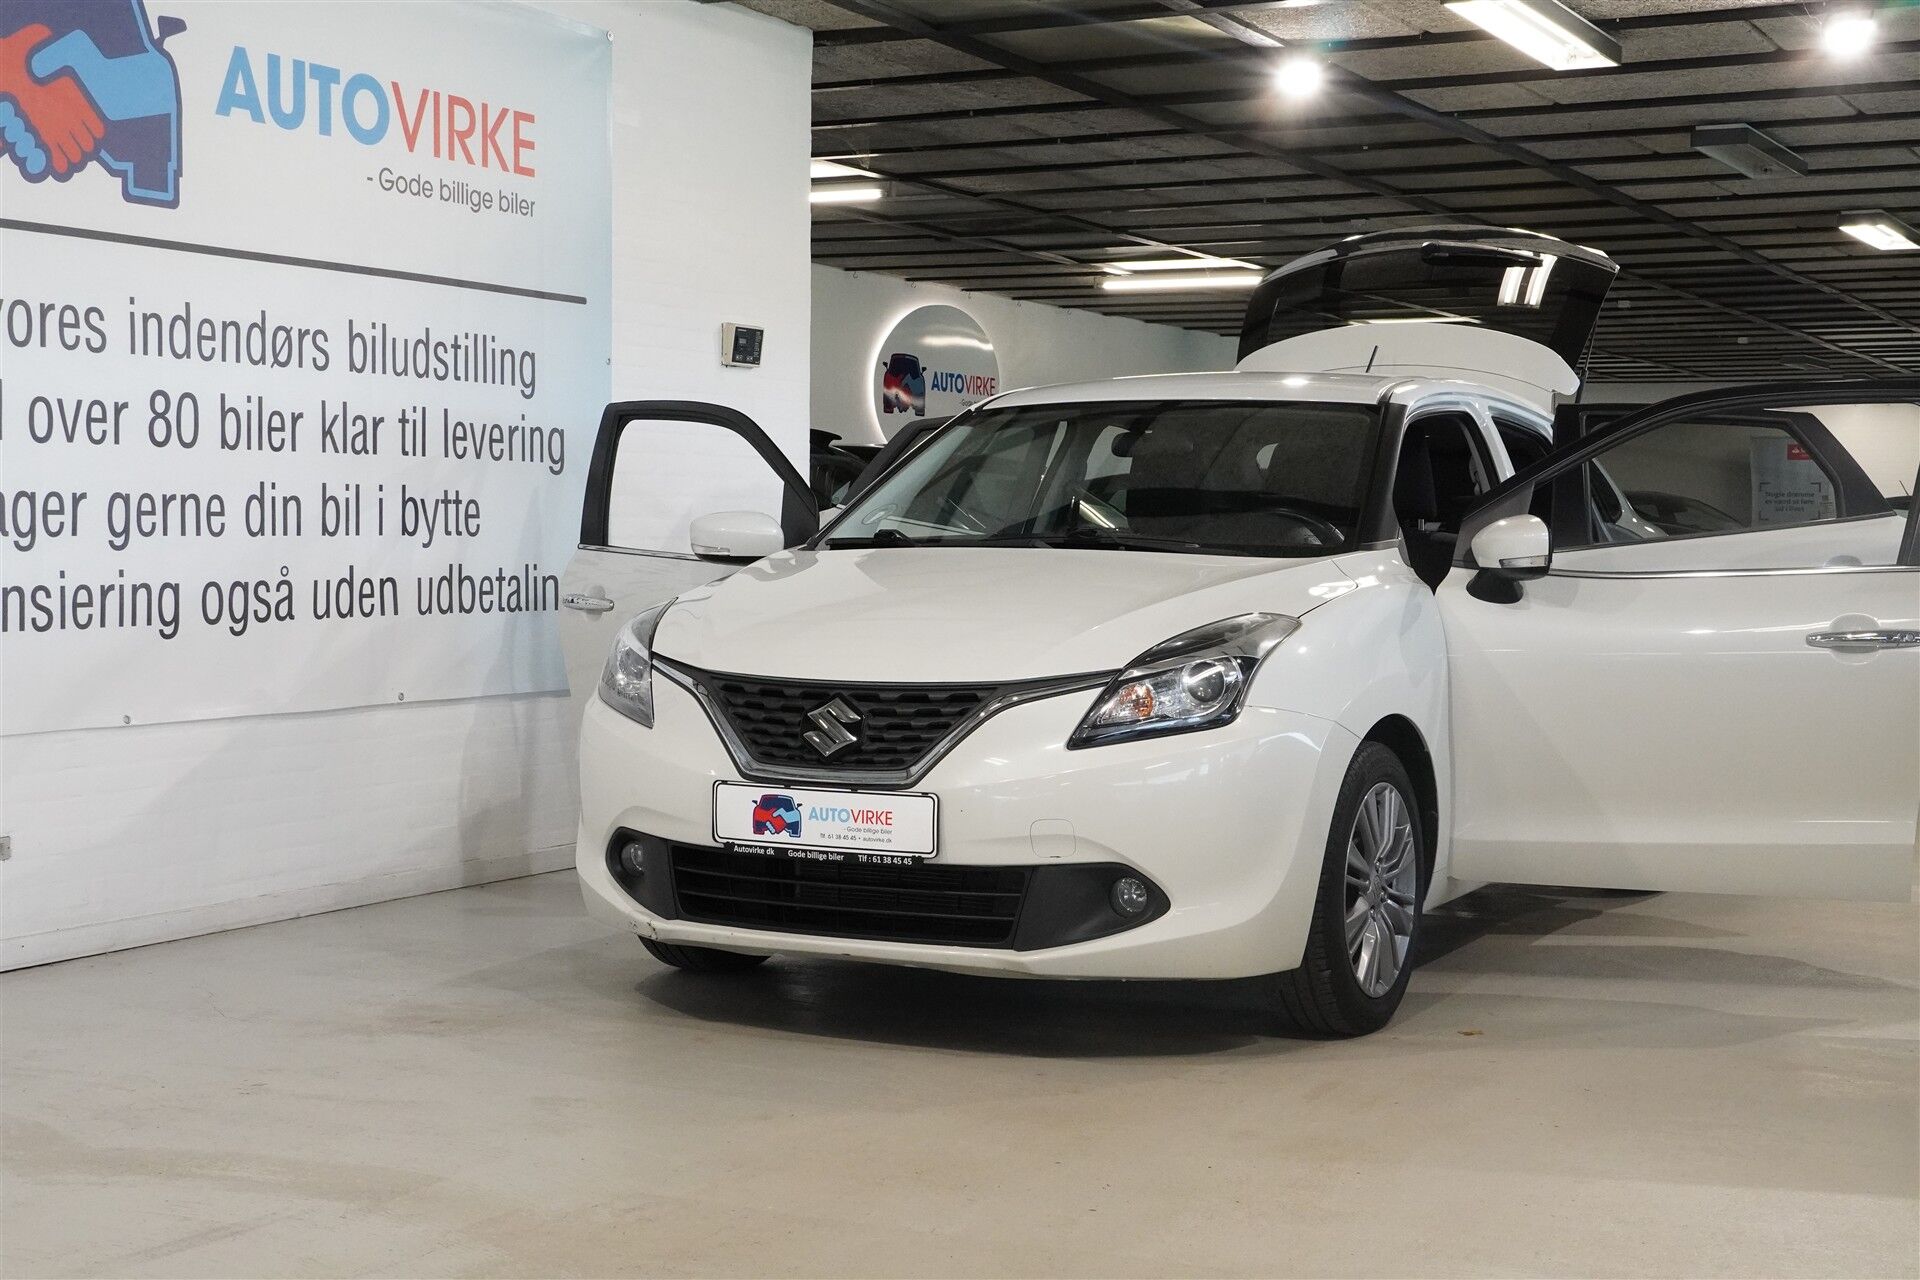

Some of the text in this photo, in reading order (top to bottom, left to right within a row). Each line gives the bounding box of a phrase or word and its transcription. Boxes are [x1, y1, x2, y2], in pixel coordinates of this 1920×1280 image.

[216, 46, 535, 178] AUTOVIRKE
[379, 167, 433, 198] Gode
[440, 178, 493, 213] billige
[499, 190, 536, 217] biler
[0, 297, 536, 399] ores indendørs biludstilling
[931, 371, 996, 396] AUTOVIRKE
[29, 396, 129, 446] over
[149, 390, 200, 450] 80
[220, 393, 304, 453] biler
[321, 400, 385, 455] klar
[398, 406, 427, 458] til
[444, 408, 566, 475] levering
[107, 492, 226, 551] gerne
[245, 482, 302, 537] din
[322, 483, 361, 537] bil
[378, 484, 384, 537] i
[402, 485, 481, 549] bytte
[202, 566, 296, 637] også
[312, 565, 399, 620] uden
[808, 806, 893, 826] AUTOVIRKE
[734, 845, 765, 855] Autovirke
[787, 849, 806, 859] Gode
[807, 851, 828, 862] billige
[828, 852, 844, 862] biler
[872, 855, 882, 864] 61
[883, 856, 892, 864] 38
[893, 857, 902, 865] 45
[903, 857, 913, 866] 45
